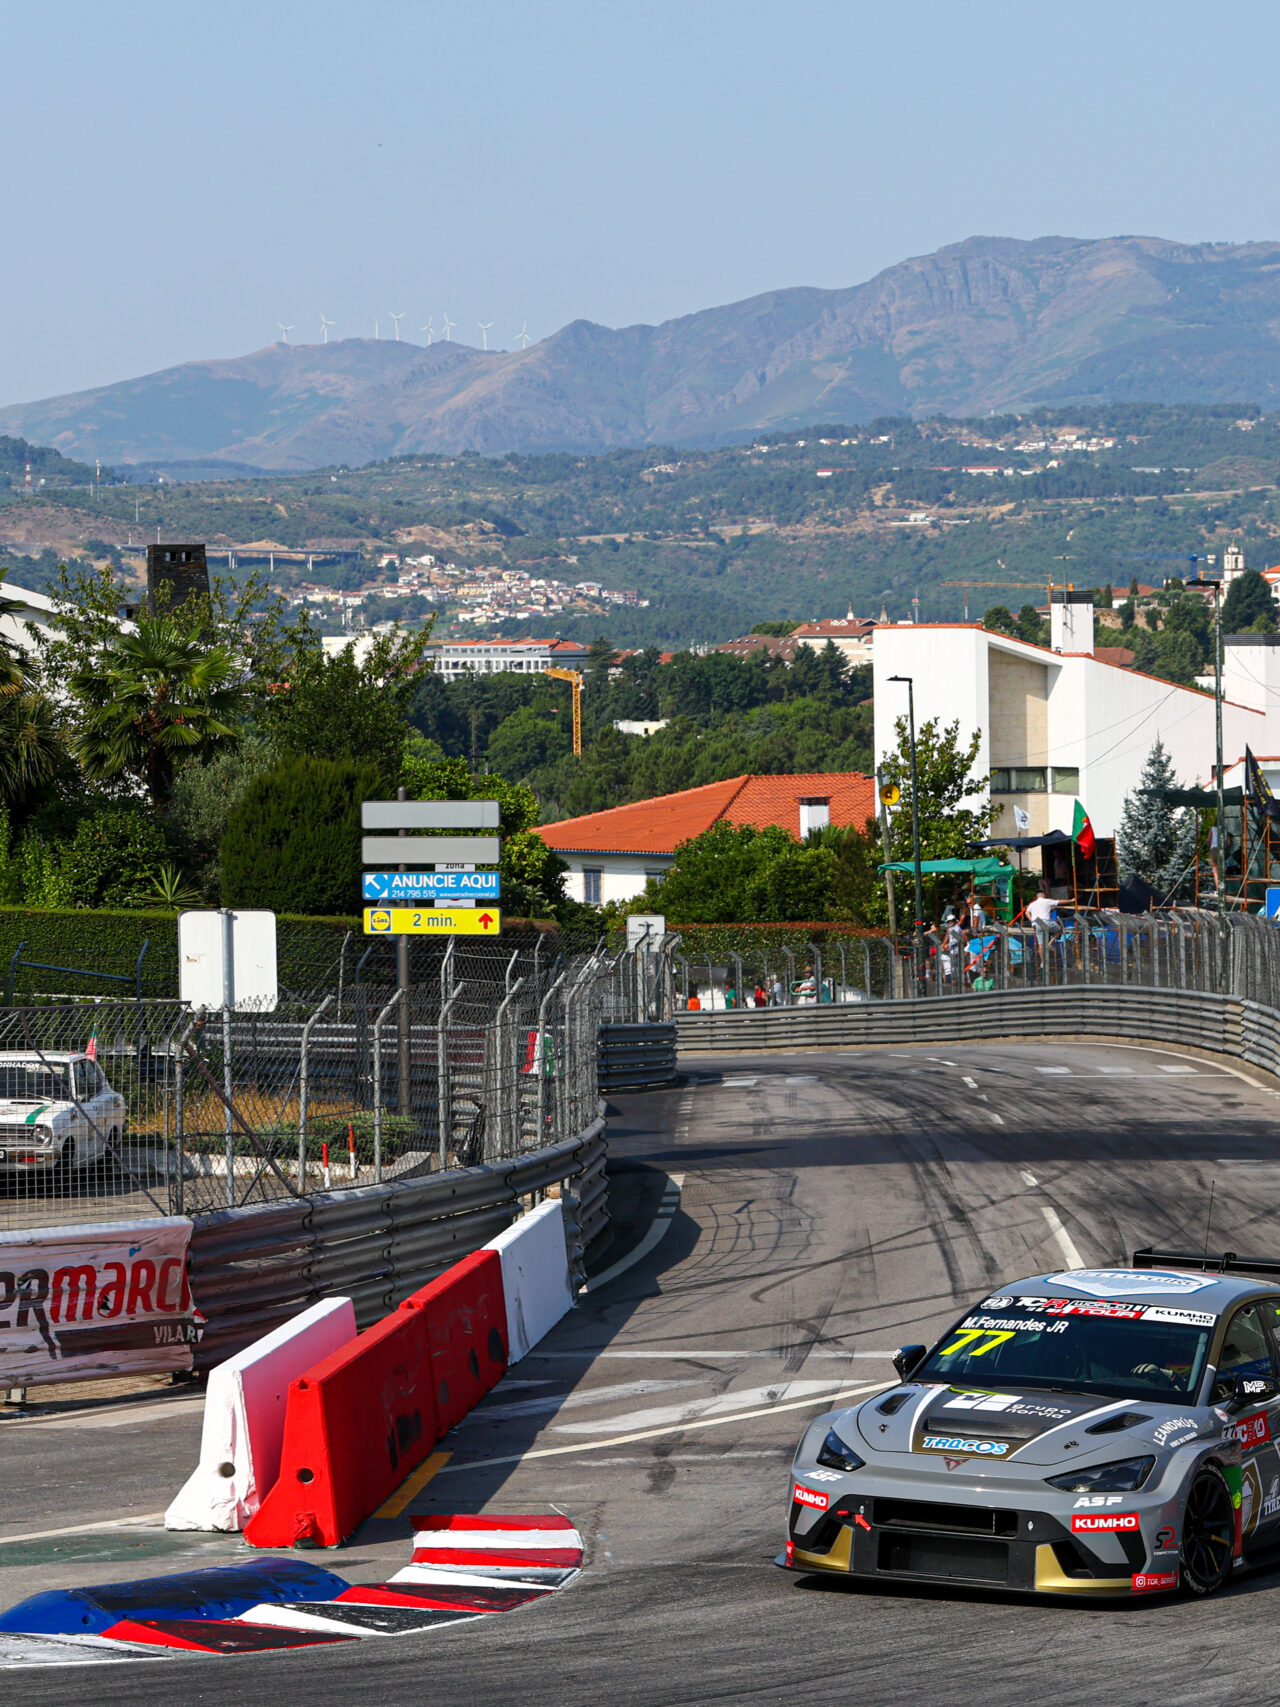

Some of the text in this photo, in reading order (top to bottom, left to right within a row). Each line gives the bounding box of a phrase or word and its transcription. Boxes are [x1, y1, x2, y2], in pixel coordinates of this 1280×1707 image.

[392, 874, 496, 888] ANUNCIE AQUI
[413, 914, 457, 926] 2 min.
[1016, 1297, 1069, 1308] TCR
[1076, 1308, 1136, 1317] TOUR
[1155, 1309, 1213, 1320] KUMHO
[961, 1316, 1069, 1333] M.Fernandes JR
[153, 1325, 184, 1343] VILA
[939, 1329, 1016, 1356] 77
[1005, 1408, 1064, 1419] norvia
[1012, 1404, 1072, 1414] grupo
[795, 1489, 826, 1506] KUMHO
[1073, 1497, 1123, 1508] ASF
[1075, 1517, 1136, 1528] KUMHO
